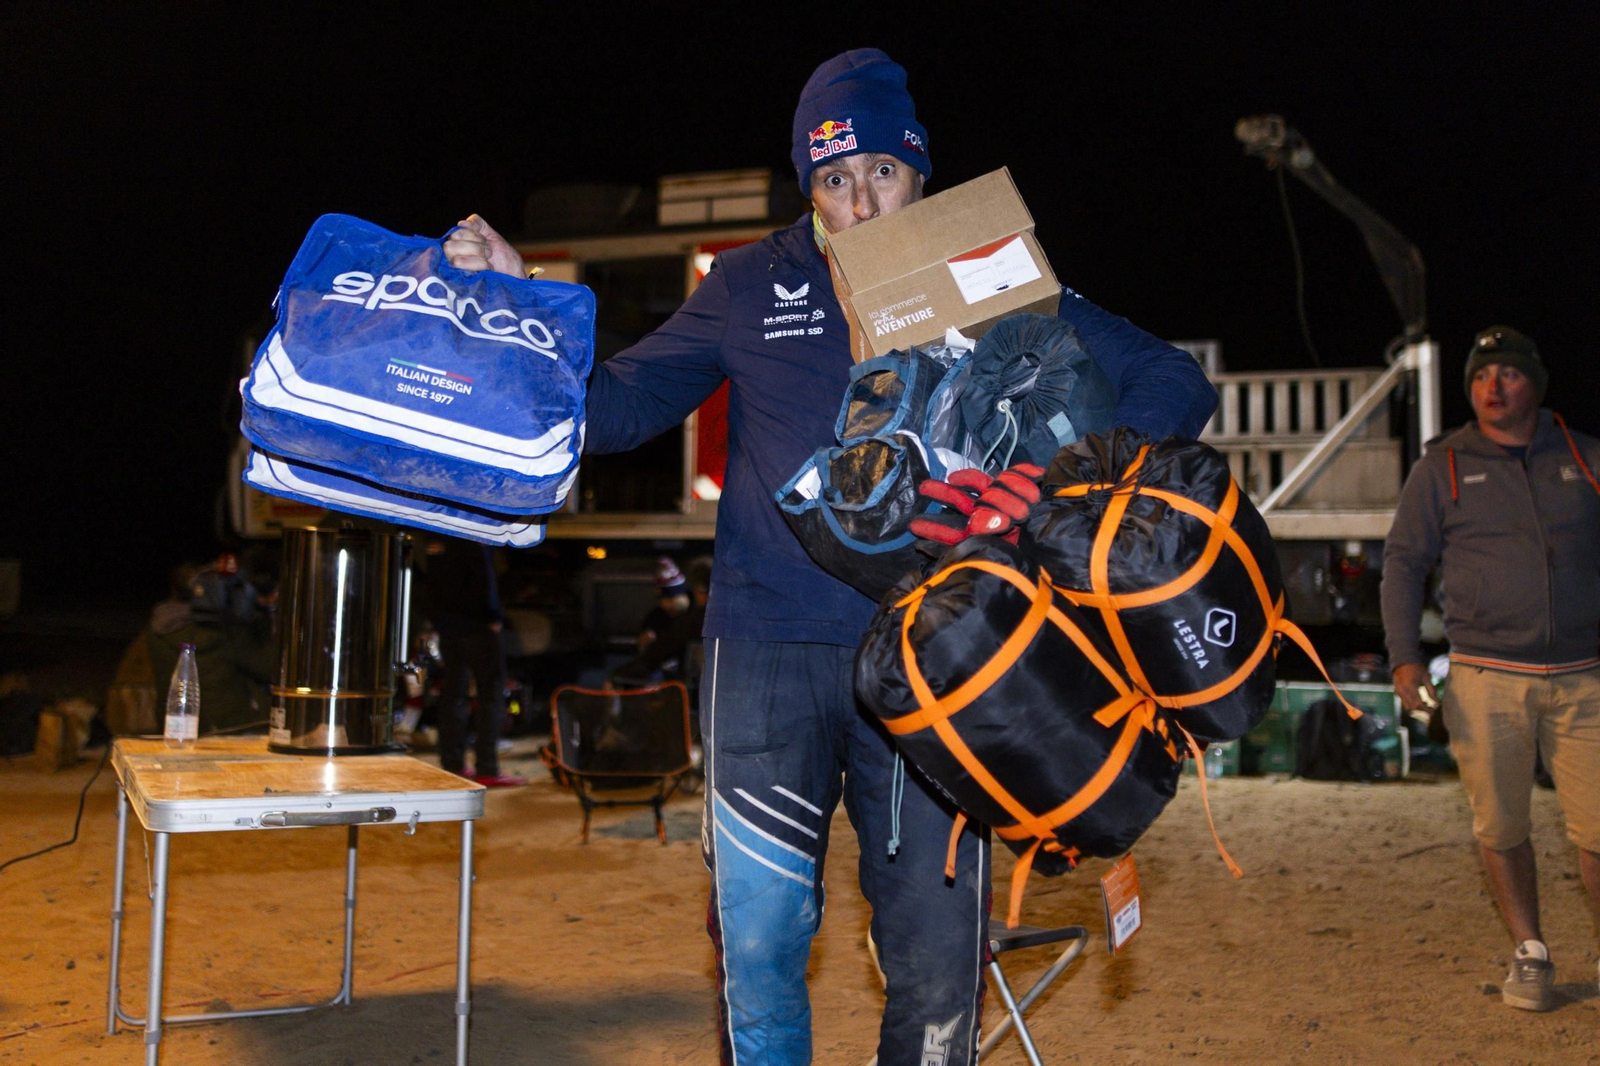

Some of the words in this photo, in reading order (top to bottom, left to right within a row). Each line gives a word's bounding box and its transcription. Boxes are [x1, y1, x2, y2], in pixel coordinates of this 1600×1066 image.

[810, 139, 832, 162] Red
[832, 134, 857, 153] Bull
[331, 271, 557, 350] sparco
[774, 300, 808, 308] CASTORE
[879, 293, 928, 315] commence
[763, 314, 809, 323] M-SPORT
[873, 312, 896, 327] votre
[875, 307, 936, 337] AVENTURE
[764, 329, 805, 340] SAMSUNG
[807, 327, 824, 335] SSD
[386, 364, 430, 385] ITALIAN
[431, 375, 473, 396] DESIGN
[396, 383, 428, 400] SINCE
[429, 392, 455, 405] 1977
[1173, 619, 1210, 669] LESTRA
